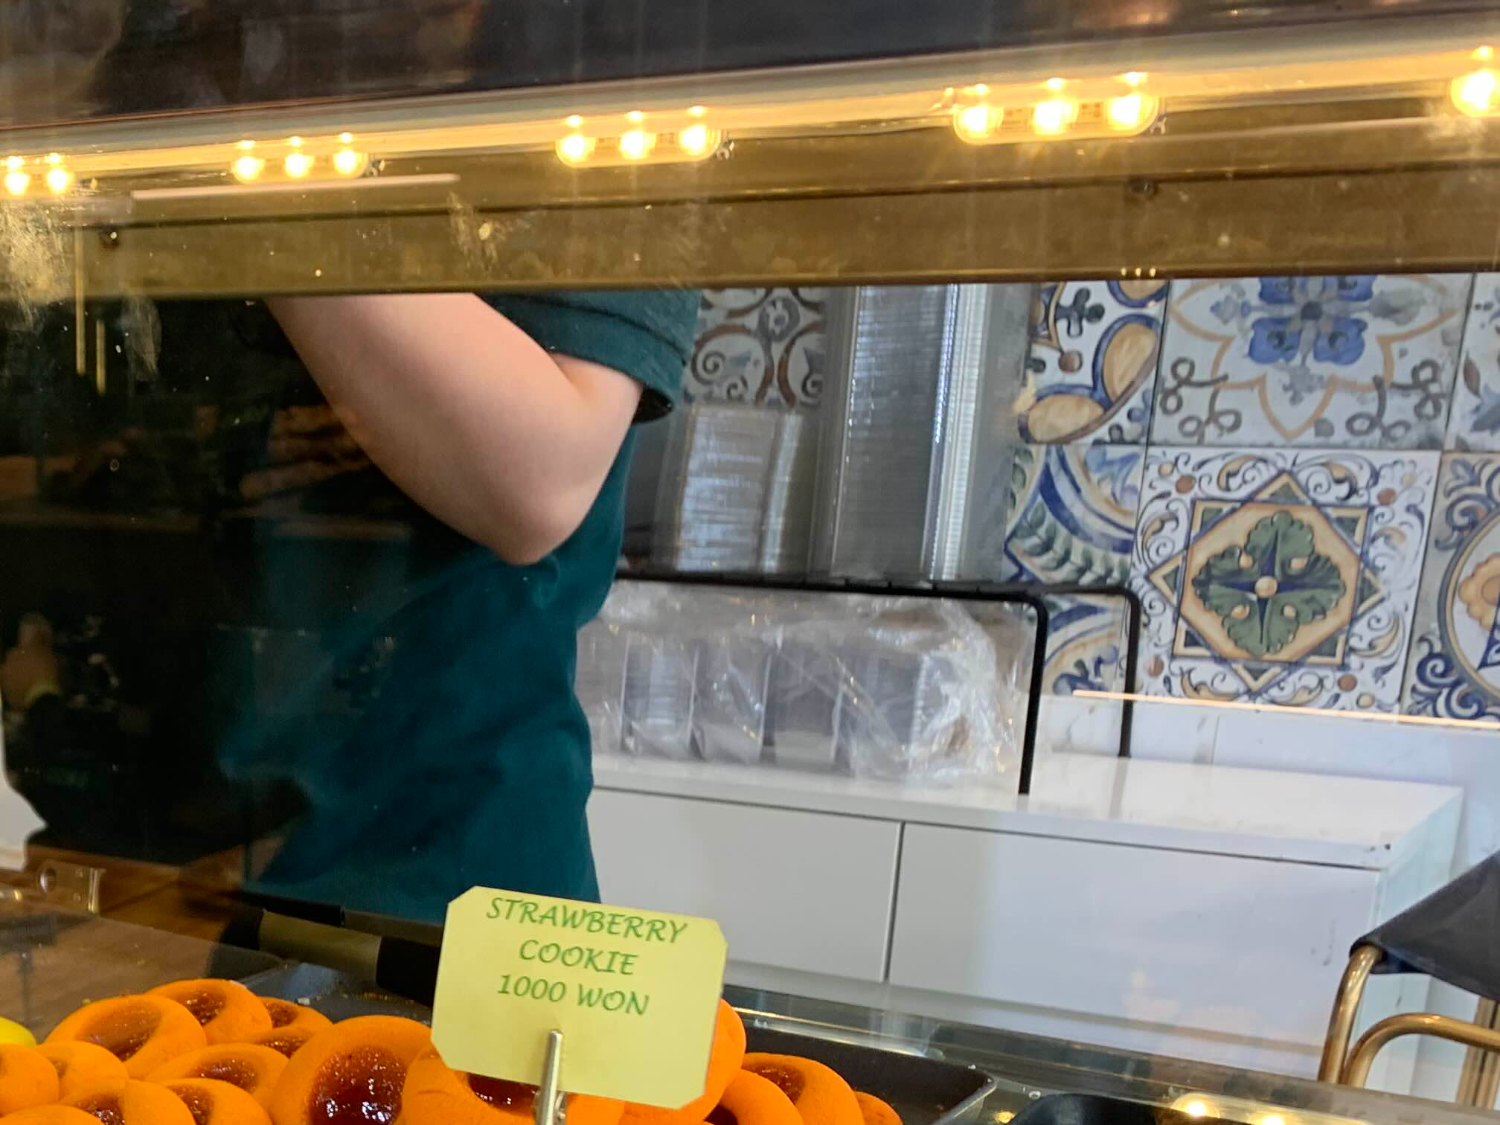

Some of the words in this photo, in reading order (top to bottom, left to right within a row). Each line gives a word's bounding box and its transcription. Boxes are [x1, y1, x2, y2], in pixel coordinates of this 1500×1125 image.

[486, 897, 688, 944] STRAWBERRY
[519, 939, 639, 976] COOKIE
[497, 974, 567, 1003] 1000
[576, 983, 650, 1017] WON
